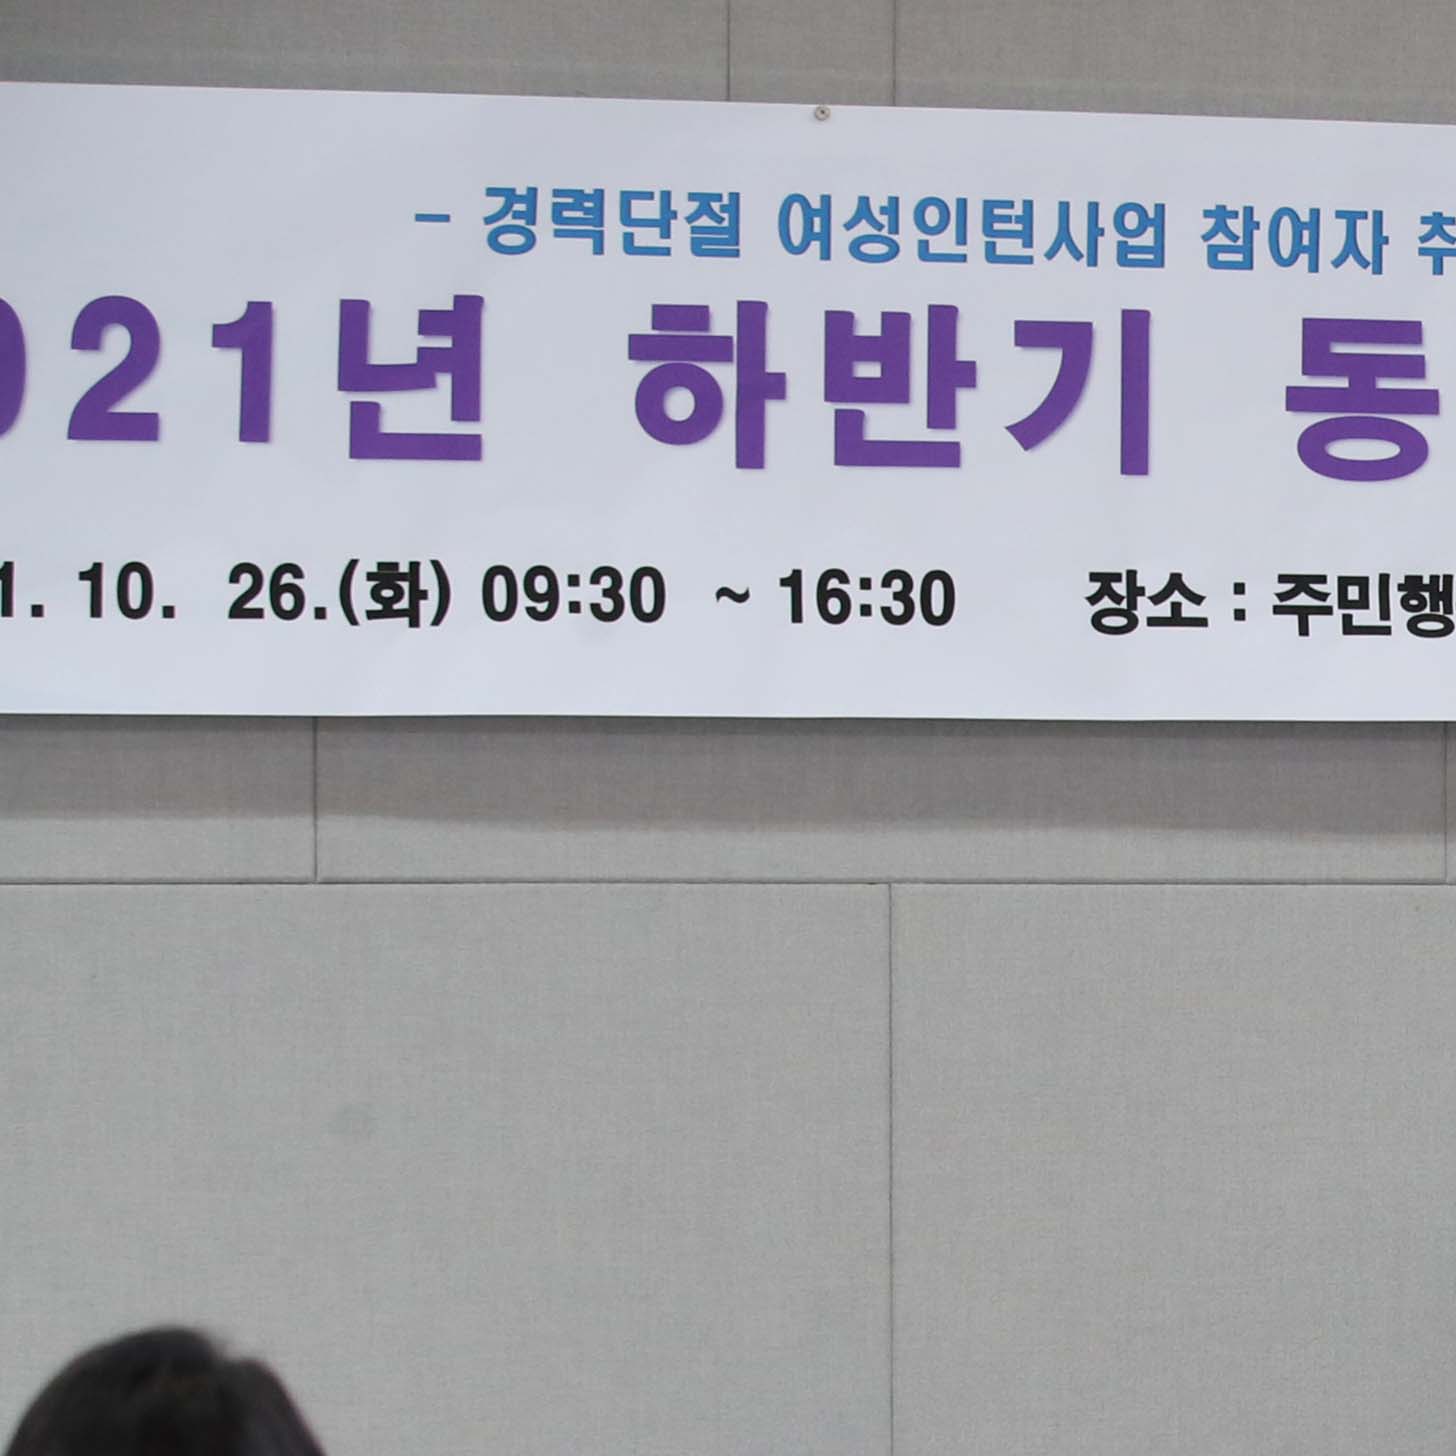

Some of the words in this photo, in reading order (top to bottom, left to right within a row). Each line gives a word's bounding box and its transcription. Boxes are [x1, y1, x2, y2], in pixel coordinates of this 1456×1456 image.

[484, 187, 742, 258] 경력단절
[779, 193, 1167, 269] 여성인턴사업
[1202, 205, 1390, 276] 참여자
[0, 295, 485, 462] 21년
[630, 300, 1152, 478] 하반기
[79, 561, 176, 620] 10.
[482, 564, 667, 624] 09:30
[779, 569, 957, 628] 16:30
[1085, 569, 1211, 637] 장소
